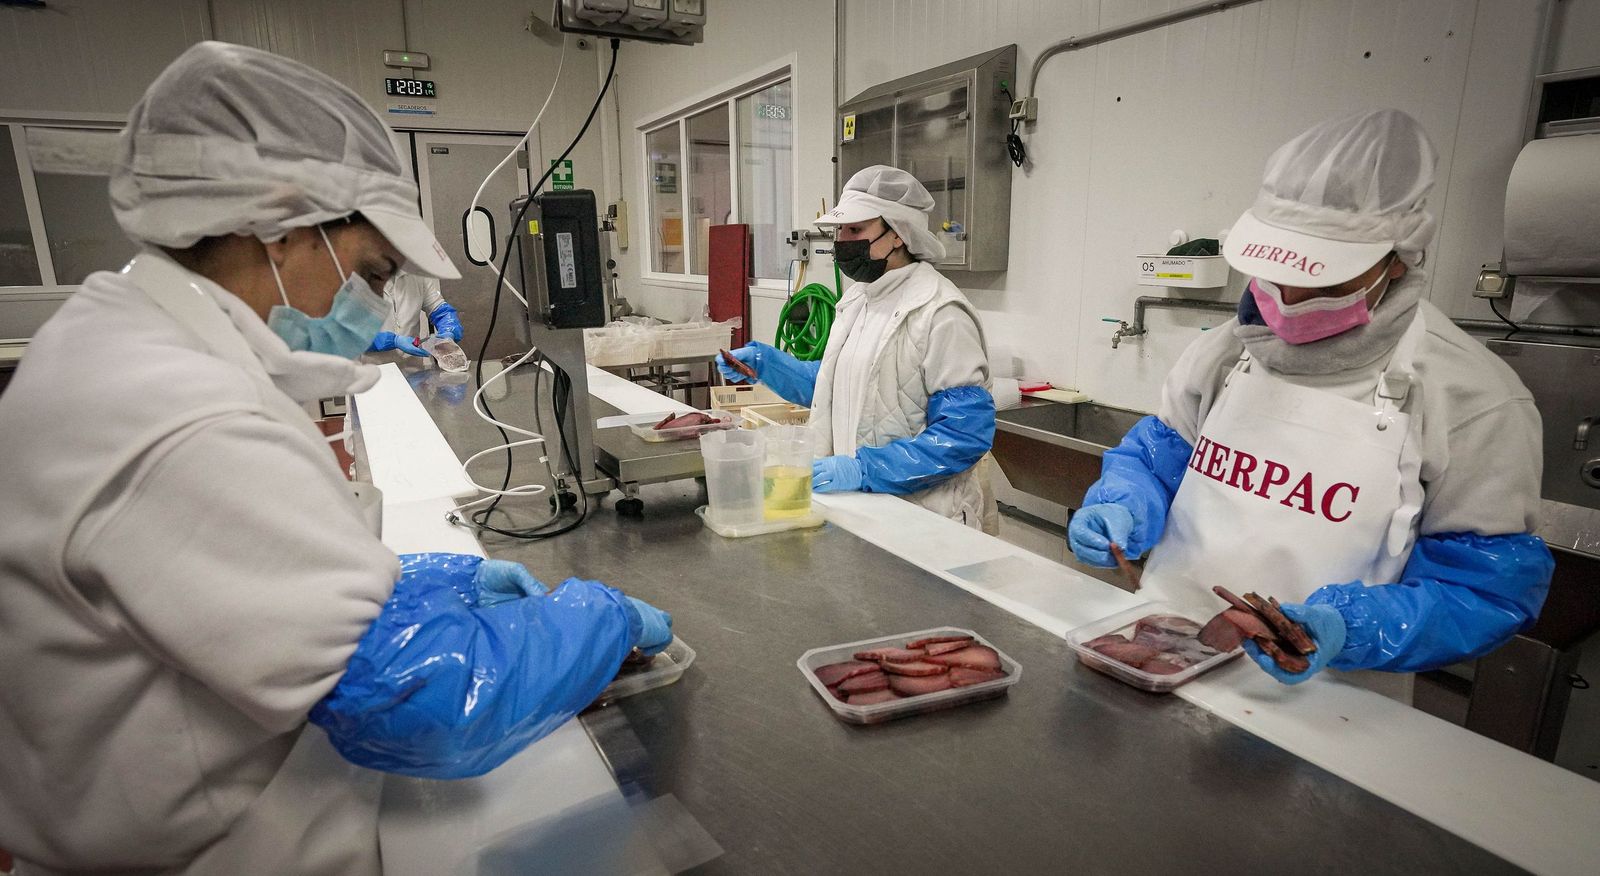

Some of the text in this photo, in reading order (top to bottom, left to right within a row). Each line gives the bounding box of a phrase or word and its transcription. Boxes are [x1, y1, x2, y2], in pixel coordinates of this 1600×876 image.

[1142, 261, 1155, 272] 05
[1241, 243, 1325, 277] HERPAC
[1189, 435, 1361, 523] HERPAC
